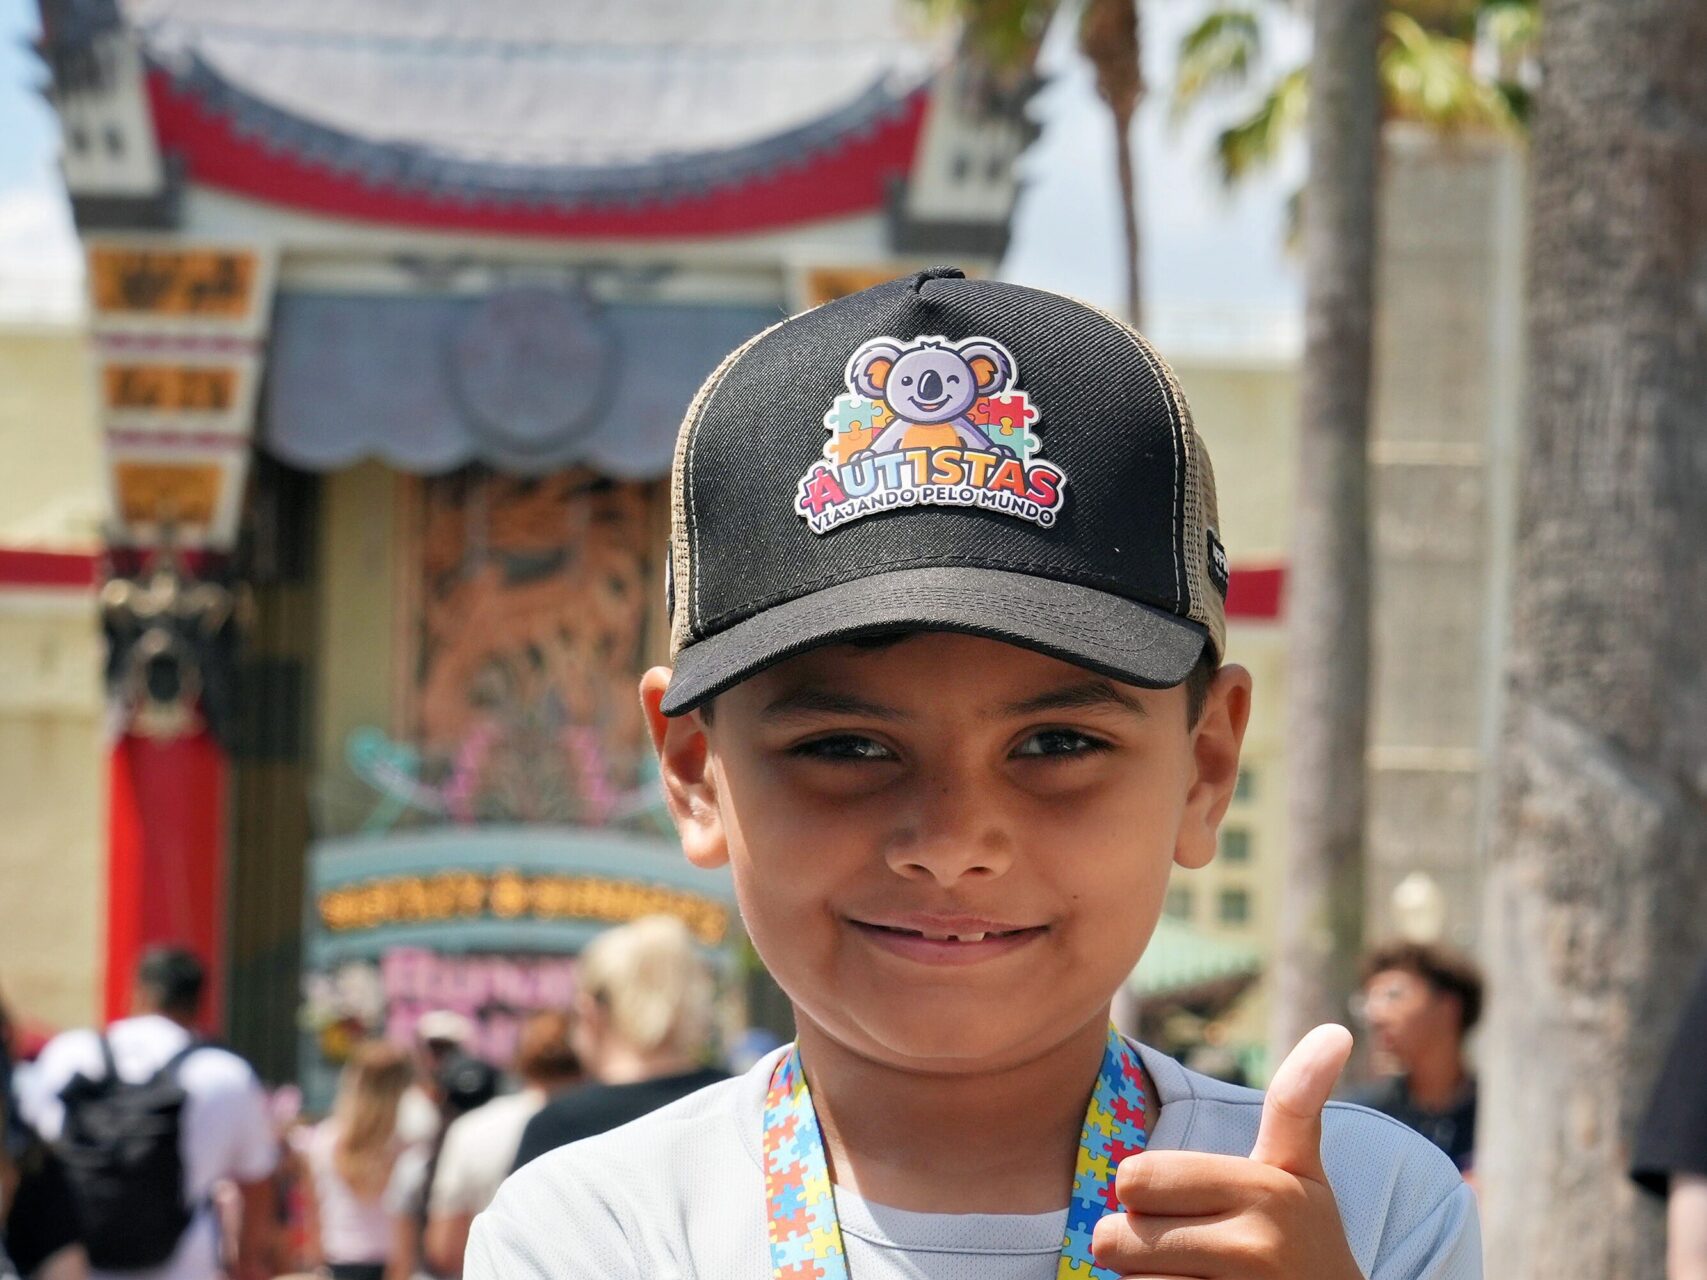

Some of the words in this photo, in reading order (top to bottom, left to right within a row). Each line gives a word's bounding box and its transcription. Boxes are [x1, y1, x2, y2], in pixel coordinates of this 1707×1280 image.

[811, 487, 916, 534] VIAJANDO
[922, 486, 975, 503] PELO
[981, 494, 1055, 528] MUNDO
